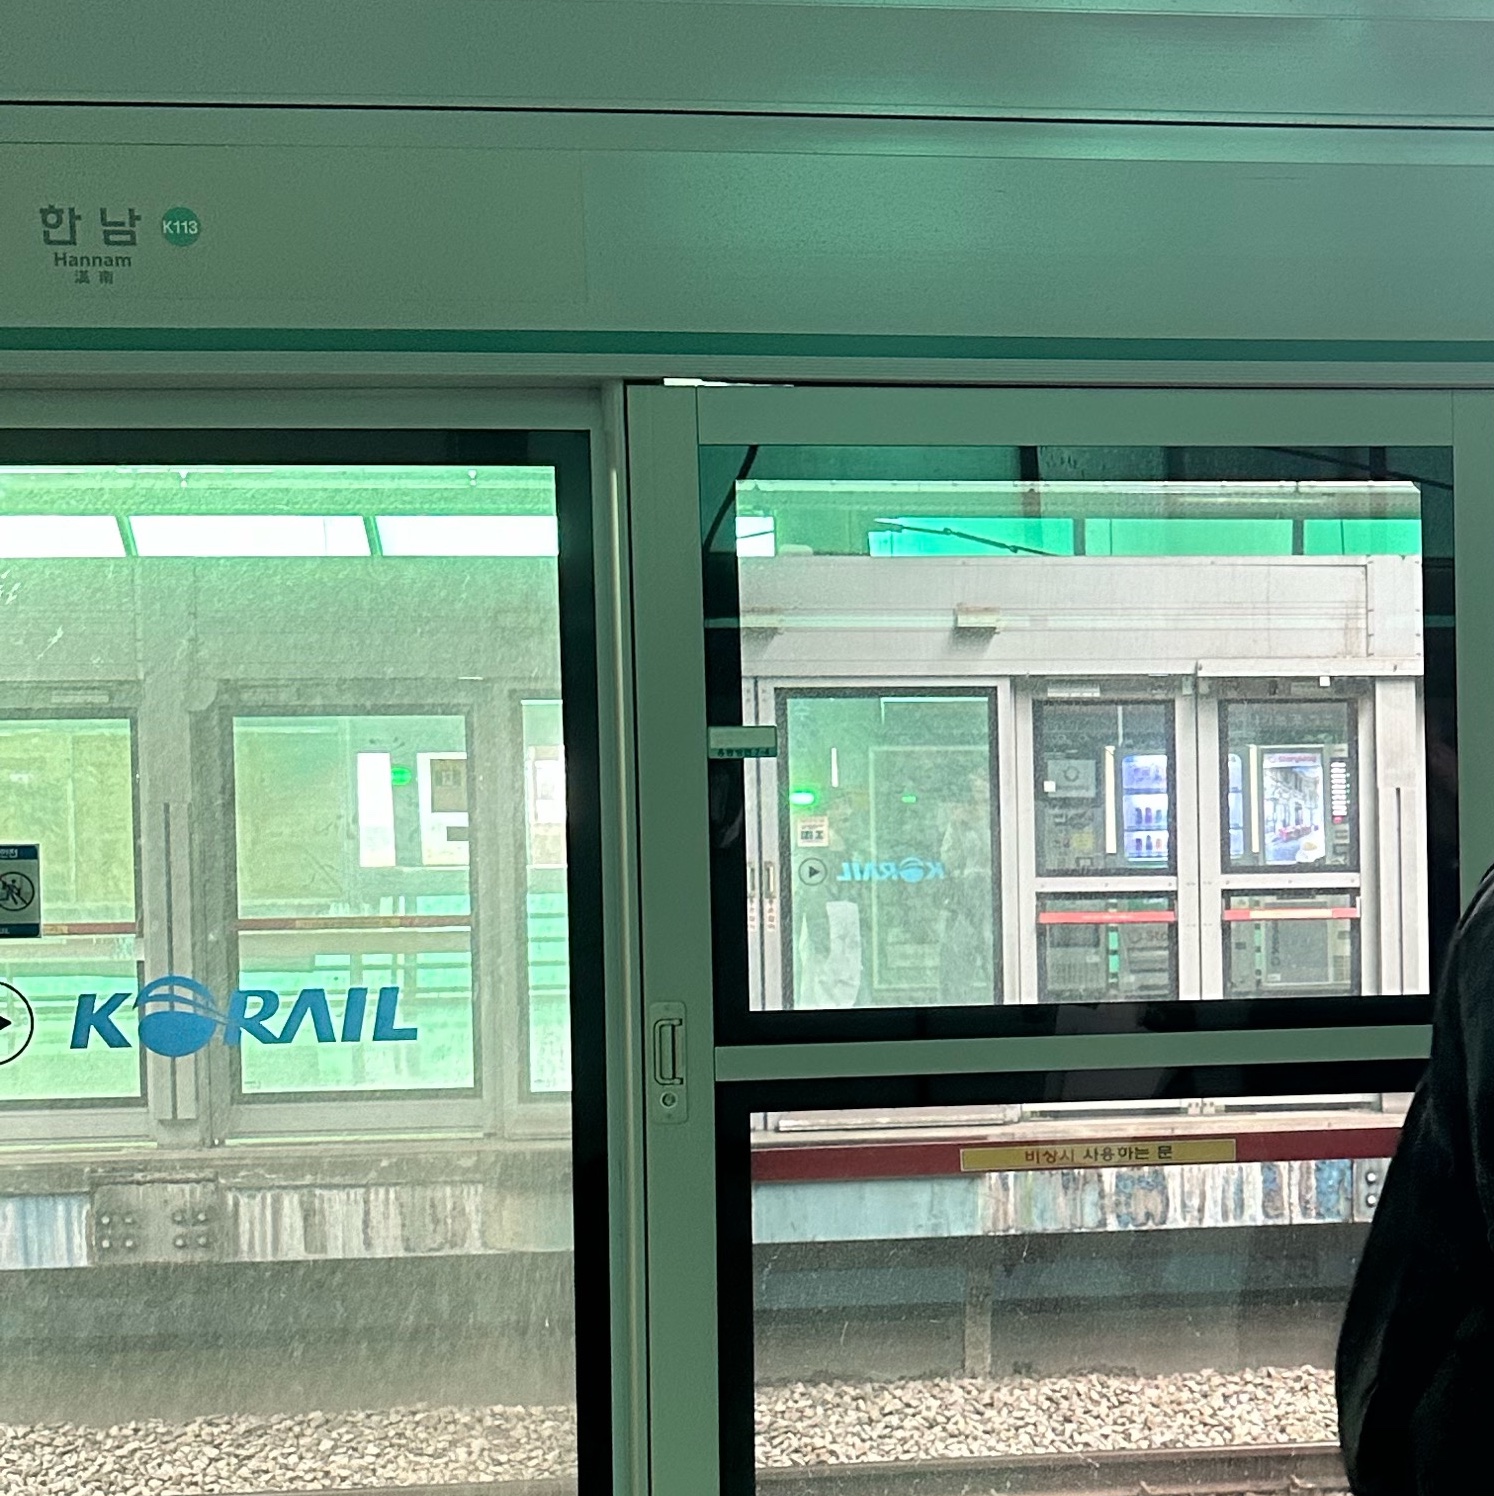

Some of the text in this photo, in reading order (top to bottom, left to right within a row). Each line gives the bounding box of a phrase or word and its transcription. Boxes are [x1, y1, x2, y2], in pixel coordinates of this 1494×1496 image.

[39, 204, 142, 246] 한남
[162, 220, 198, 235] K113
[54, 252, 132, 267] Hannam
[70, 975, 418, 1057] KORAIL
[1025, 1145, 1173, 1164] 비상시 사용하는 문
